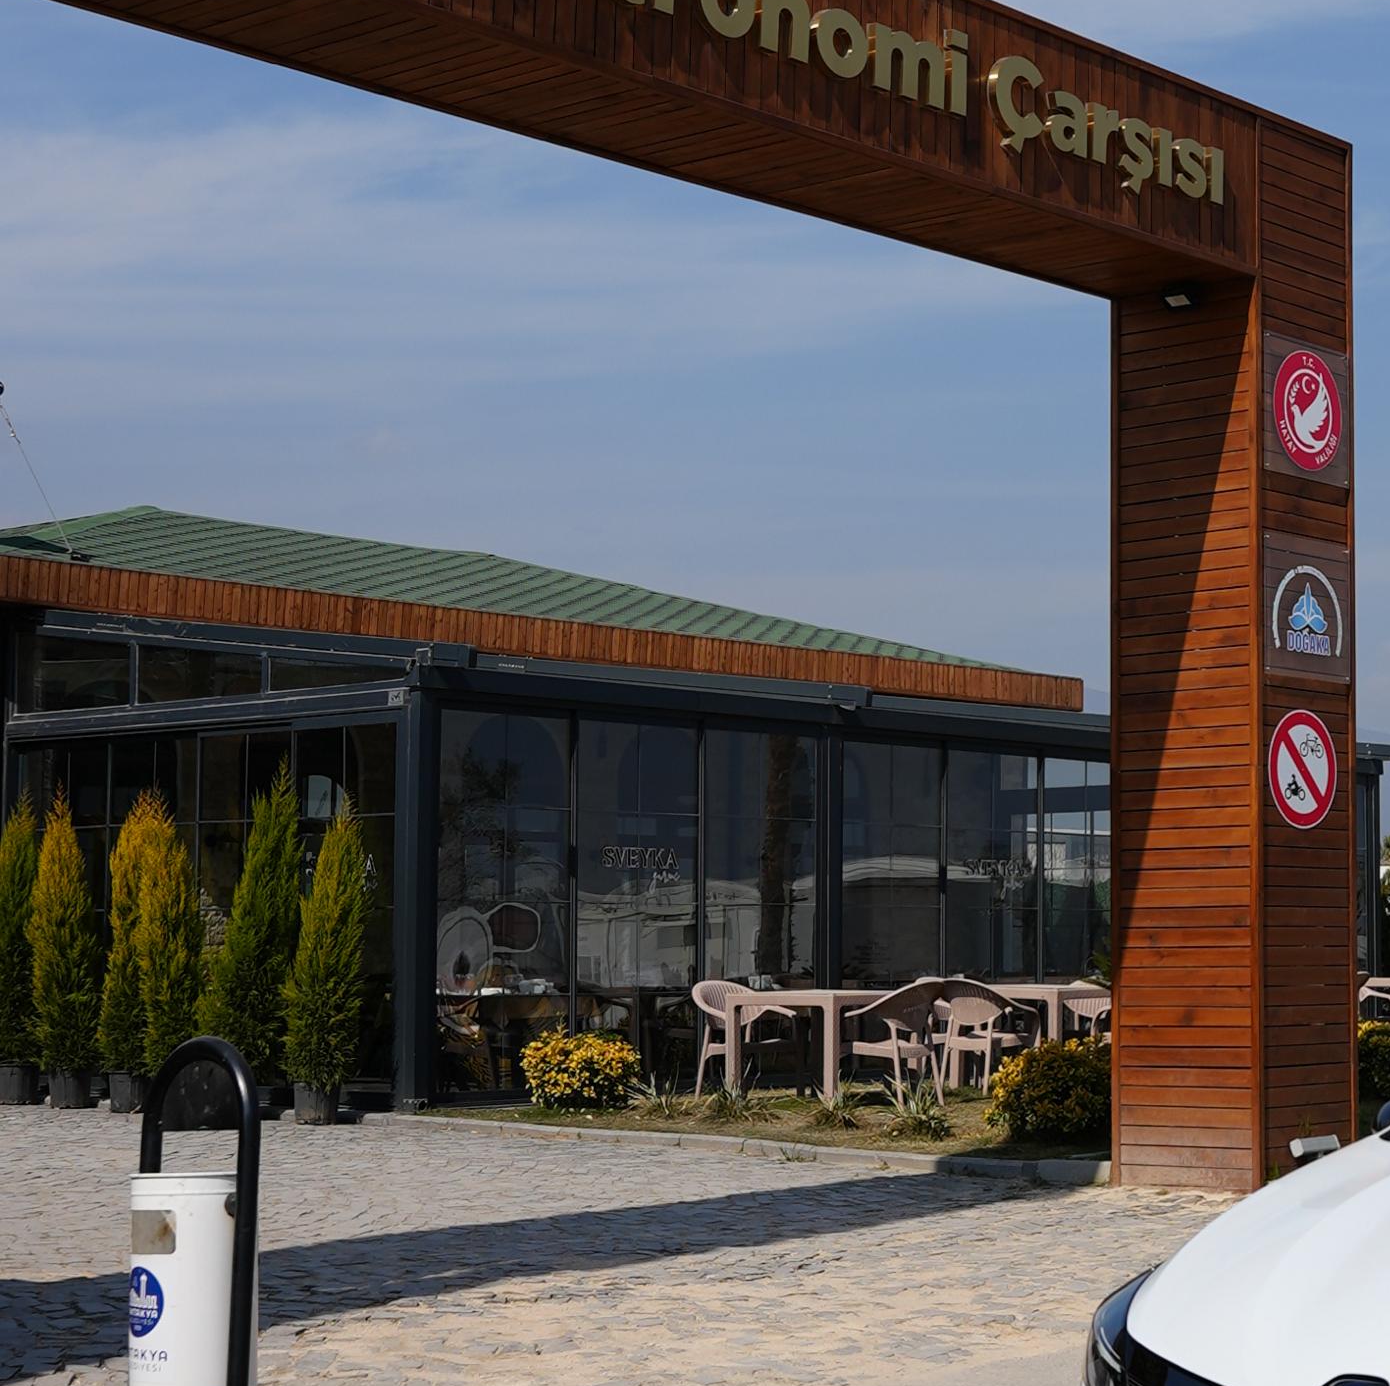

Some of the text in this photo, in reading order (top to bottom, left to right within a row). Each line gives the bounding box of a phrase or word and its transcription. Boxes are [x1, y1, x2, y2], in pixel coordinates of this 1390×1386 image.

[987, 55, 1224, 206] Çarşısı
[1279, 419, 1297, 454] HATAY
[602, 846, 679, 870] SVEYKA
